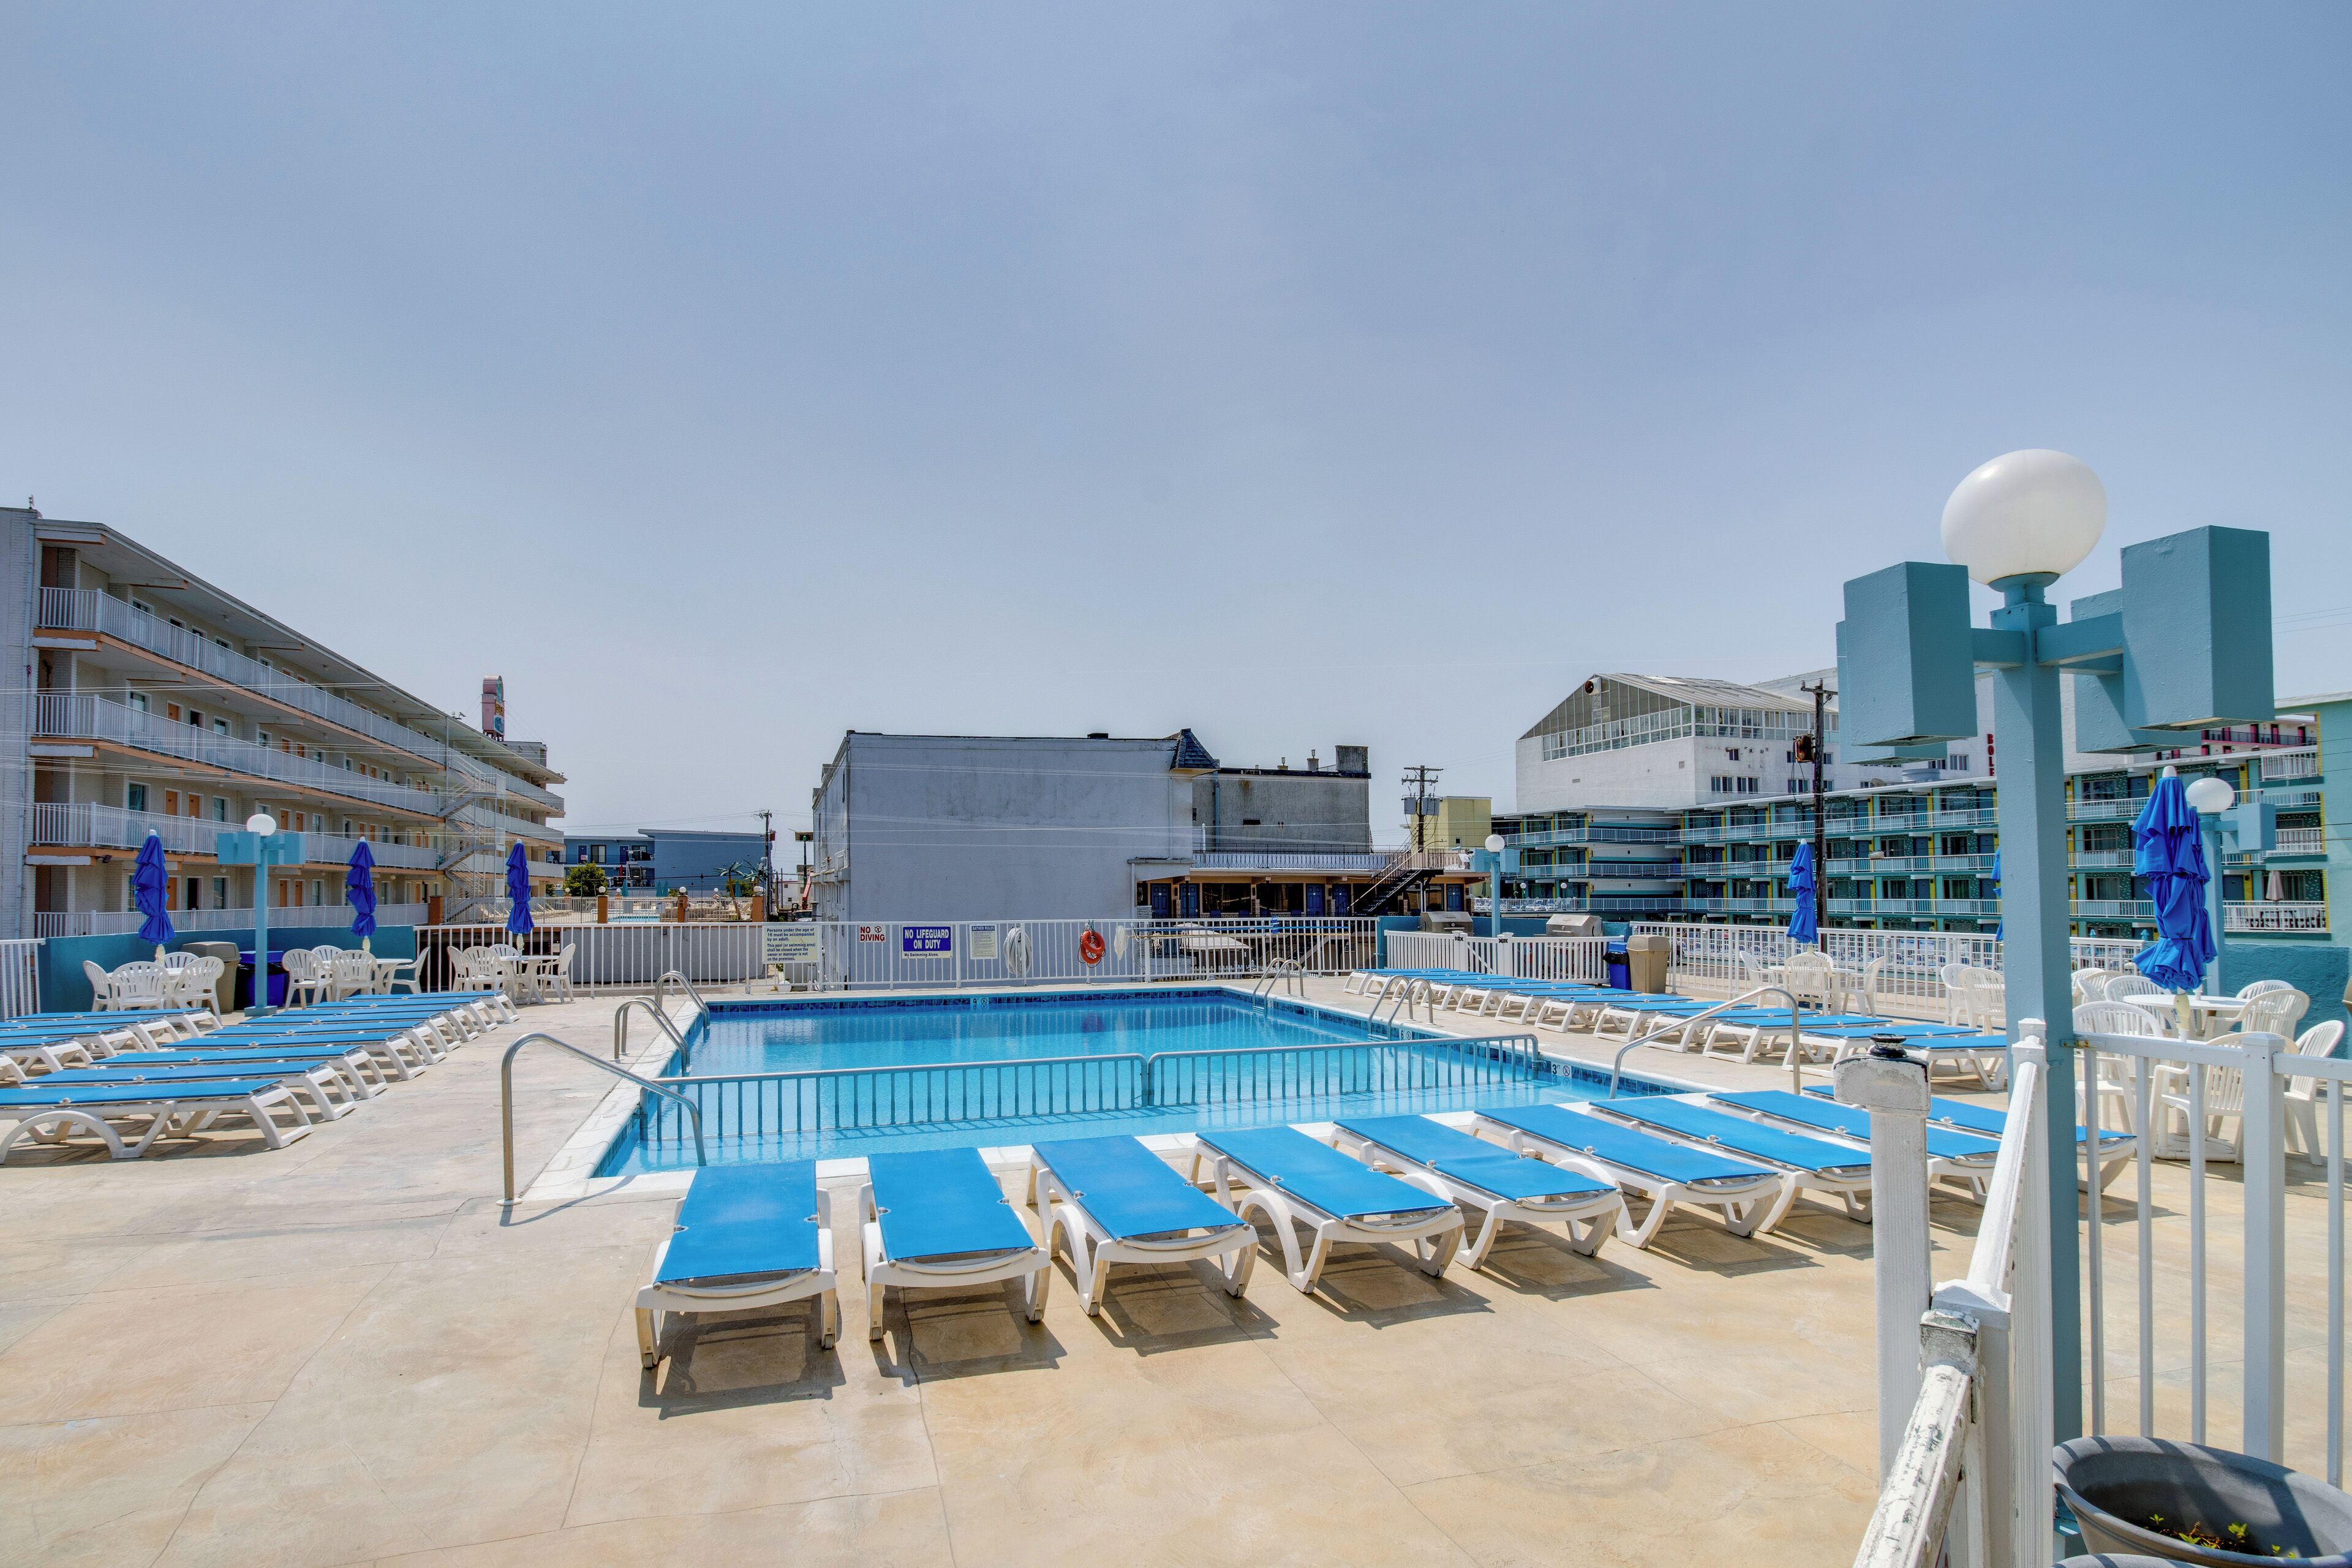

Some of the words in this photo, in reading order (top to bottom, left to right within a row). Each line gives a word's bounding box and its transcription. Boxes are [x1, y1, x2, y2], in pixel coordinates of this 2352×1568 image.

[905, 929, 914, 939] NO
[916, 929, 949, 939] LIFEGUARD
[913, 939, 922, 949] ON
[925, 939, 940, 949] DUTY
[1401, 1030, 1404, 1039] 6
[1552, 1064, 1557, 1074] 3
